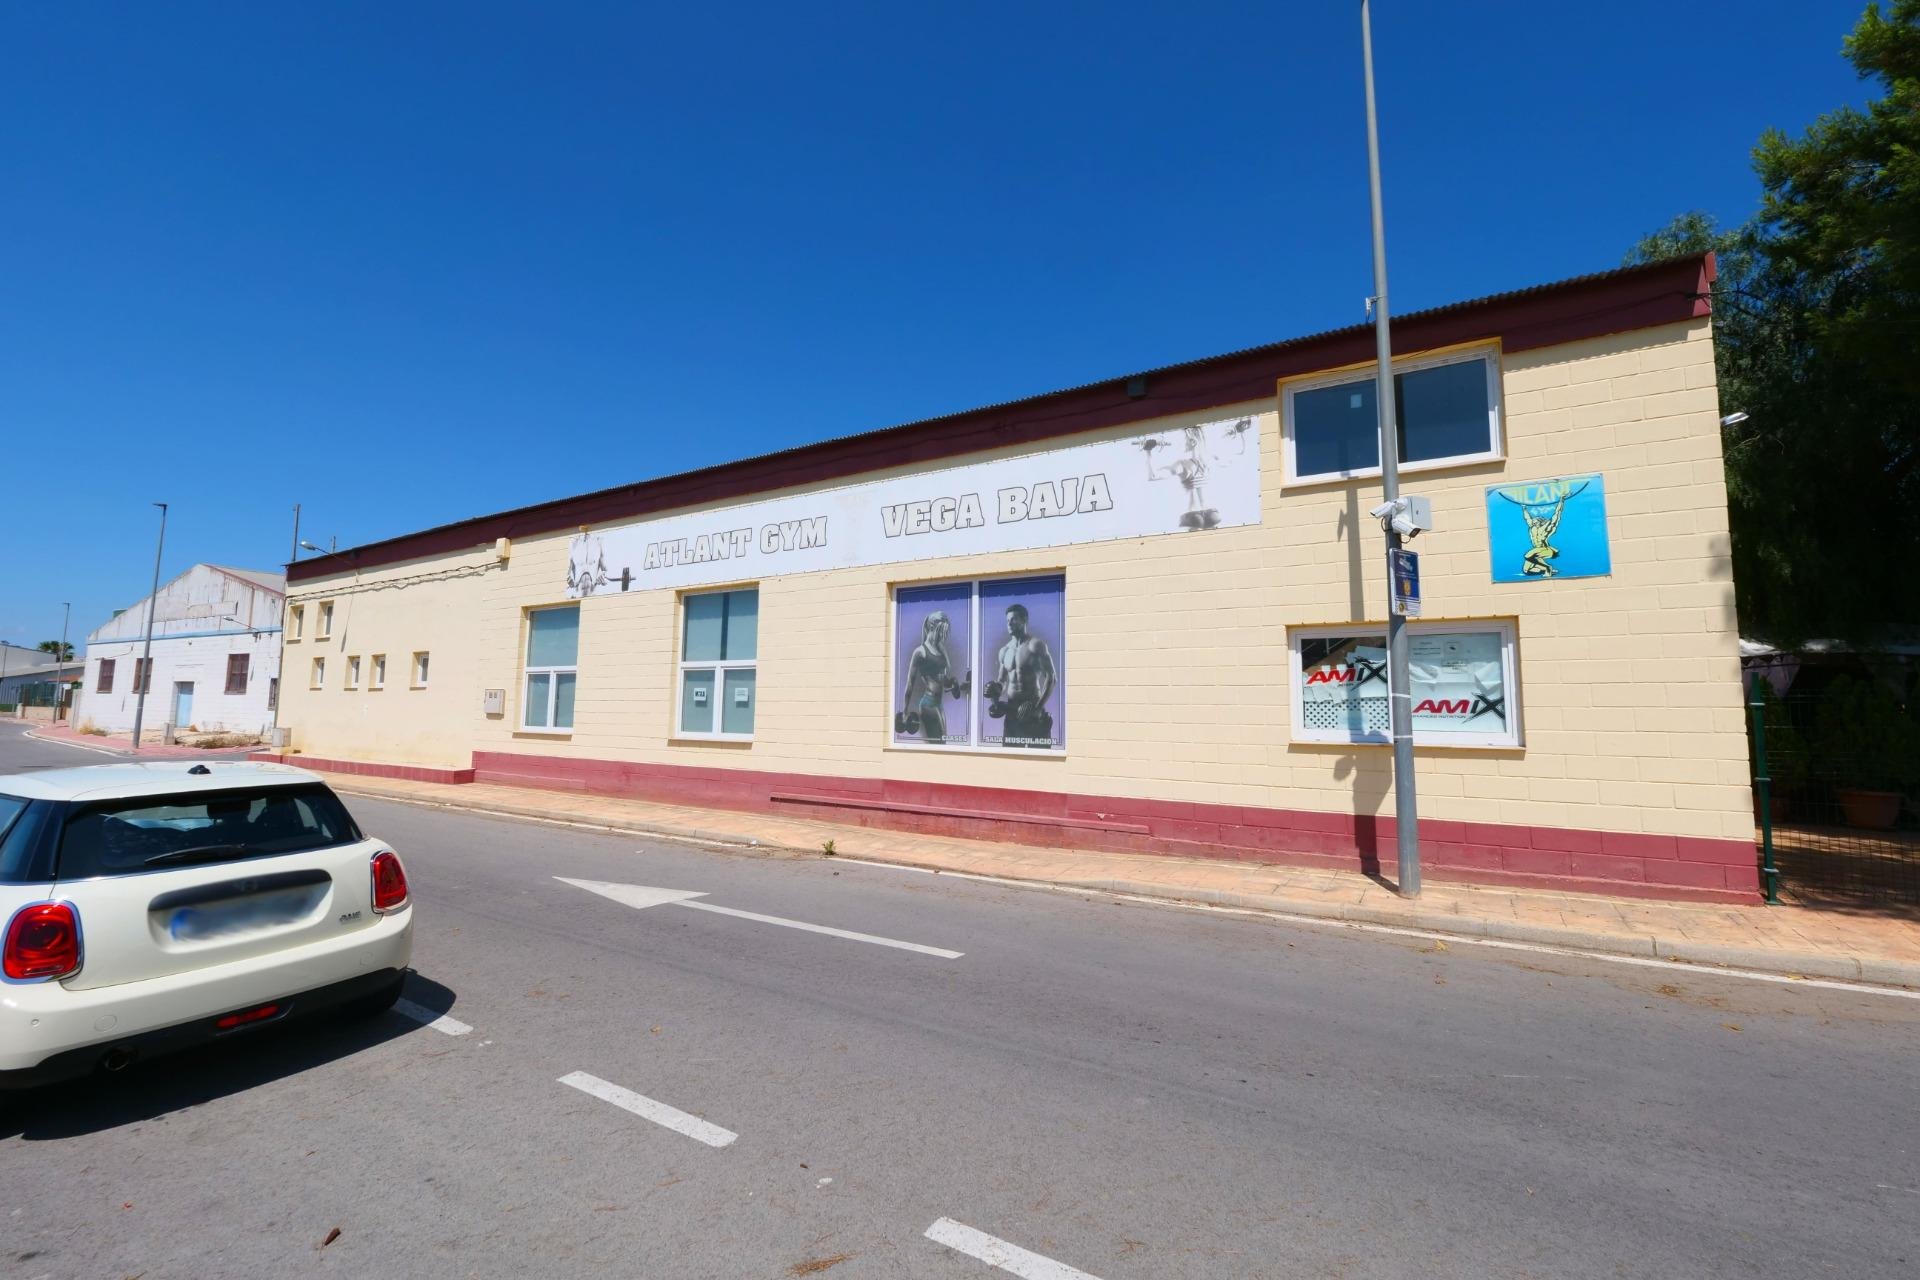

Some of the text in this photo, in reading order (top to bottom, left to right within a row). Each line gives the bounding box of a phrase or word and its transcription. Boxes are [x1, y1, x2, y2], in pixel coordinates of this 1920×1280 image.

[643, 473, 1113, 570] ATLANT GYM VEGA BAJA
[1412, 692, 1505, 724] AMIX
